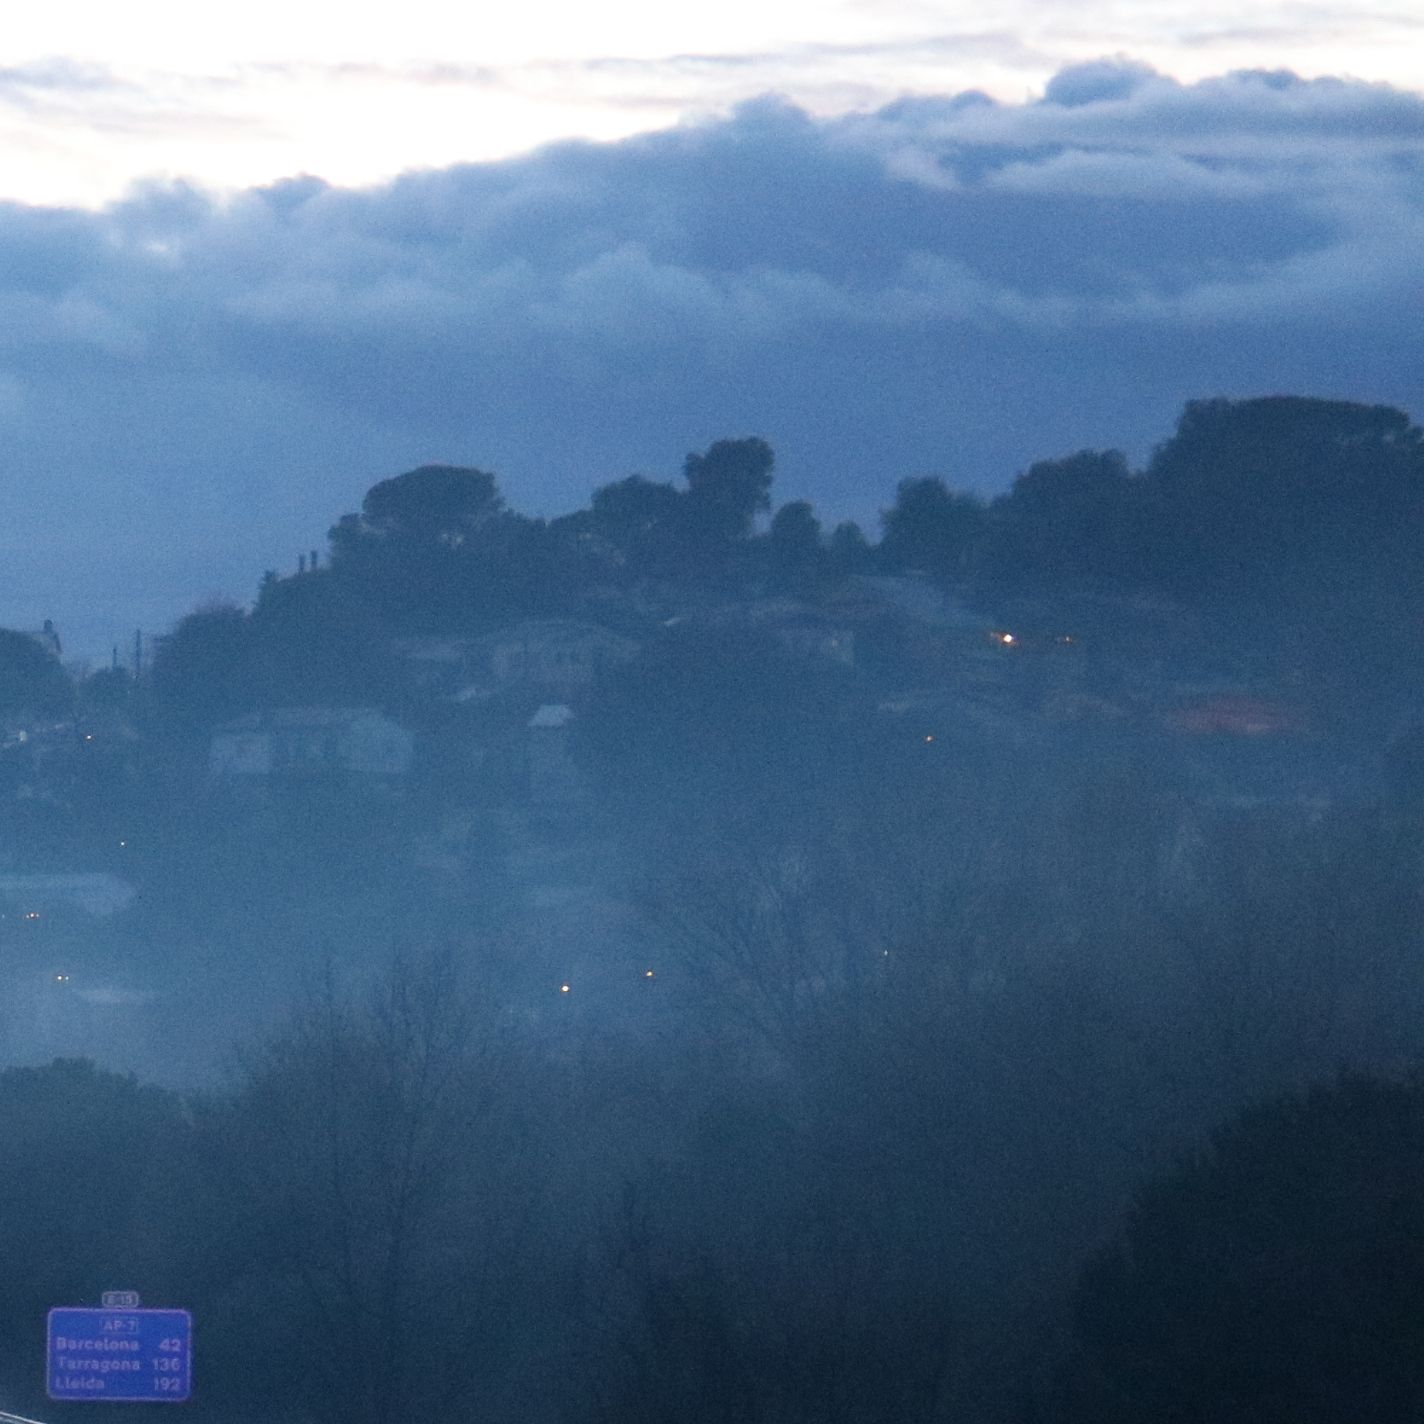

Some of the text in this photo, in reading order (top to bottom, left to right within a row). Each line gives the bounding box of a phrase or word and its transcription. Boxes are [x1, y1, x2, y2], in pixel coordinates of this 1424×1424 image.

[103, 1320, 135, 1331] AP-7
[55, 1336, 182, 1352] Barcelona 42
[57, 1356, 141, 1373] Tarragona
[55, 1376, 105, 1389] Lleida
